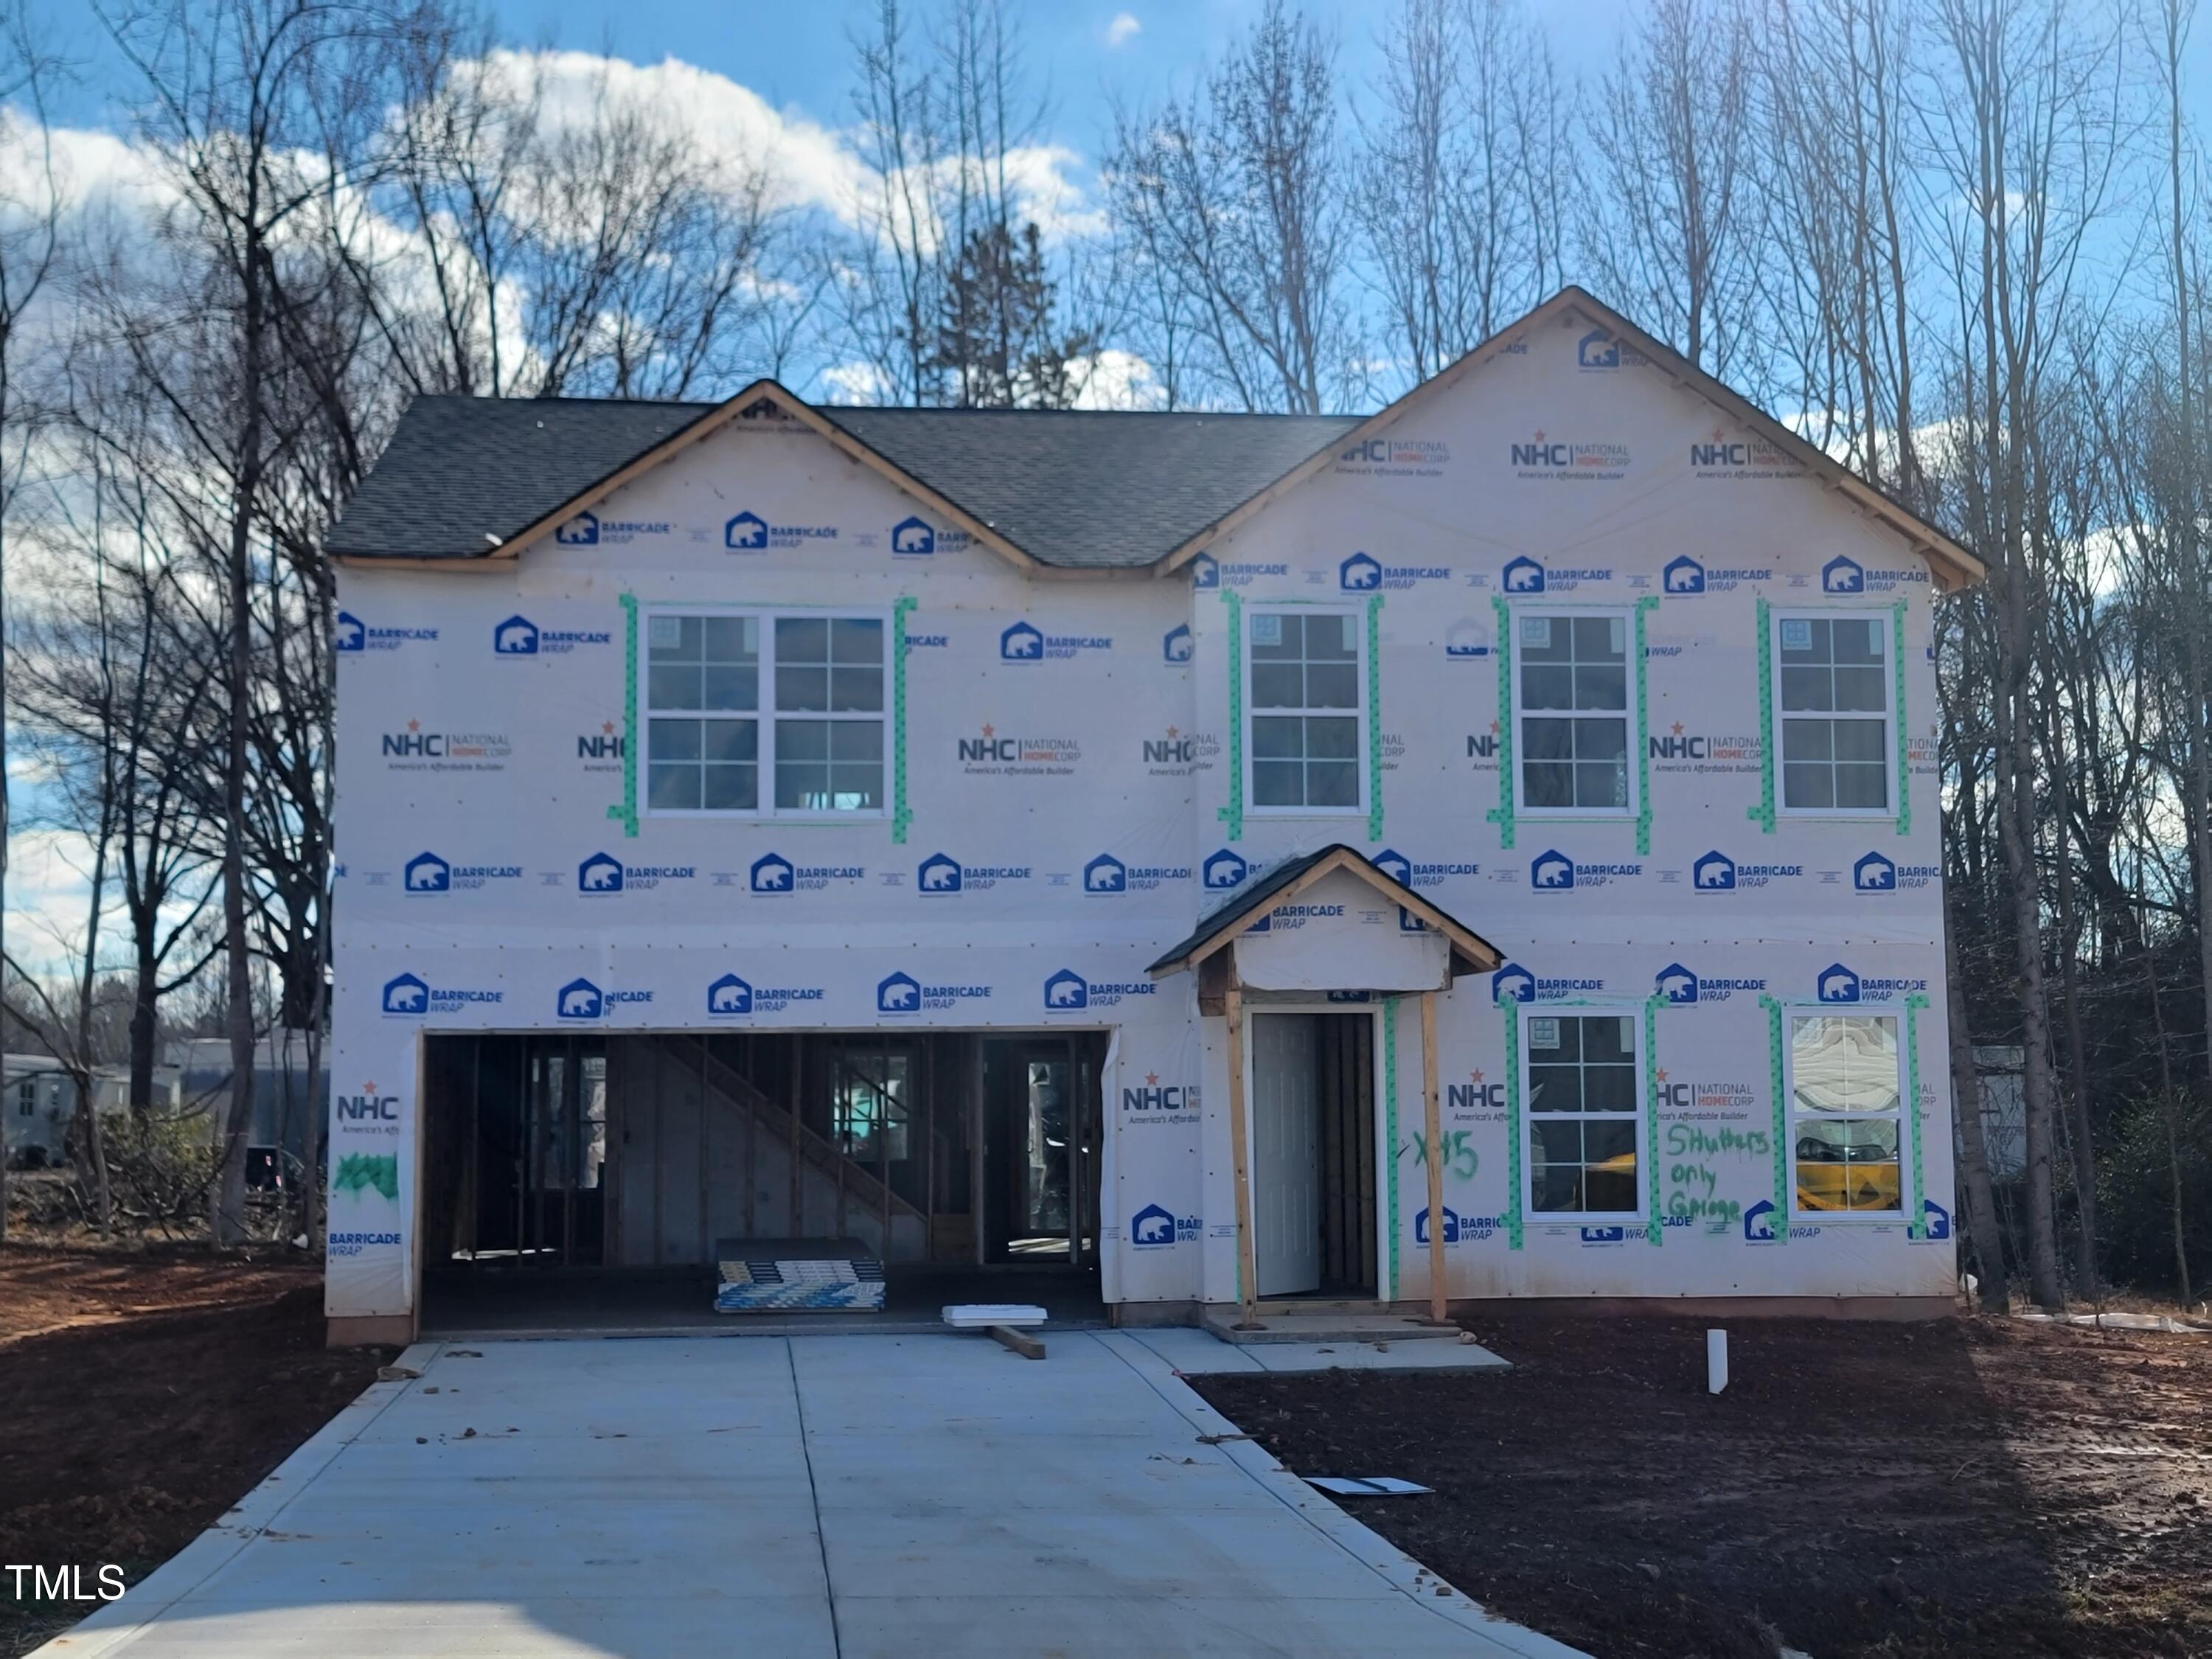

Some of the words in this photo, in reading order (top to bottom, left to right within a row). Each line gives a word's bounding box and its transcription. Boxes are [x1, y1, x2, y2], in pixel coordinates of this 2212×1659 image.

[1392, 442, 1447, 452] NATIONAL
[1576, 445, 1628, 456] NATIONAL
[1512, 444, 1565, 466] NHC
[1691, 444, 1745, 466] NHC
[1374, 467, 1413, 478] Affordable
[1416, 469, 1443, 477] Builder
[1557, 472, 1598, 481] Affordable
[1600, 472, 1624, 481] Builder
[602, 523, 669, 534] BARRICADE
[771, 527, 838, 538] BARRICADE
[602, 535, 633, 543] WRAP
[771, 539, 803, 548] WRAP
[1221, 565, 1287, 575] BARRICADE
[1385, 568, 1450, 580] BARRICADE
[1548, 570, 1612, 580] BARRICADE
[1708, 570, 1771, 580] BARRICADE
[1221, 577, 1252, 586] WRAP
[1866, 571, 1929, 582] BARRICADE
[1384, 580, 1415, 590] WRAP
[1548, 581, 1577, 591] WRAP
[1708, 582, 1736, 591] WRAP
[1866, 582, 1896, 591] WRAP
[369, 629, 438, 641] BARRICADE
[542, 633, 611, 644] BARRICADE
[369, 641, 401, 650] WRAP
[905, 636, 949, 647] RICADE
[1046, 638, 1113, 648] BARRICADE
[542, 644, 574, 653] WRAP
[1652, 647, 1681, 656] WRAP
[1046, 650, 1077, 658] WRAP
[451, 734, 509, 745] NATIONAL
[1714, 738, 1761, 748] NATIONA
[383, 734, 442, 757] NHC
[960, 739, 1015, 761] NHC
[1025, 740, 1079, 751] NATIONAL
[1467, 735, 1500, 757] NH
[1649, 737, 1704, 758] NHC
[1380, 747, 1405, 757] CORP
[1714, 749, 1761, 759] HOMECOR
[430, 763, 473, 772] Affordable
[476, 763, 504, 771] Builder
[1004, 767, 1043, 776] Affordable
[1472, 762, 1500, 771] Americ
[1694, 765, 1733, 774] Affordable
[453, 867, 522, 877] BARRICADE
[626, 868, 695, 878] BARRICADE
[796, 869, 864, 878] BARRICADE
[964, 869, 1031, 878] BARRICADE
[1414, 865, 1479, 874] BARRICADE
[1576, 866, 1643, 875] BARRICADE
[1738, 866, 1803, 876] BARRICADE
[1899, 867, 1941, 877] BARRIC
[452, 880, 484, 890] WRAP
[625, 880, 658, 890] WRAP
[796, 880, 828, 890] WRAP
[964, 880, 995, 890] WRAP
[1128, 880, 1159, 890] WRAP
[1413, 875, 1444, 886] WRAP
[1576, 877, 1606, 886] WRAP
[1738, 877, 1769, 887] WRAP
[1899, 877, 1928, 888] WRAP
[1273, 905, 1344, 917] BARRICADE
[1273, 918, 1305, 929] WRAP
[1090, 984, 1157, 994] BARRICADE
[1537, 980, 1604, 990] BARRICADE
[1700, 980, 1766, 990] BARRICADE
[1862, 980, 1927, 990] BARRICADE
[431, 992, 503, 1002] BARRICADE
[755, 990, 823, 1000] BARRICADE
[923, 987, 991, 998] BARRICADE
[1537, 991, 1568, 999] WRAP
[1700, 991, 1731, 1001] WRAP
[1862, 991, 1892, 1001] WRAP
[923, 998, 955, 1009] WRAP
[1090, 995, 1121, 1006] WRAP
[431, 1003, 464, 1012] WRAP
[754, 1001, 787, 1011] WRAP
[1698, 1084, 1753, 1094] NATIONAL
[1123, 1088, 1178, 1110] NHC
[1449, 1085, 1504, 1107] NHC
[1657, 1084, 1688, 1106] HC
[338, 1096, 398, 1121] NHC
[1677, 1112, 1718, 1121] Affordable
[1461, 1218, 1500, 1228] BARRIC
[1461, 1229, 1492, 1239] WRAP
[1625, 1229, 1649, 1239] WRA
[1789, 1228, 1820, 1238] WRAP
[330, 1234, 400, 1244] BARRICADE
[329, 1246, 362, 1256] WRAP
